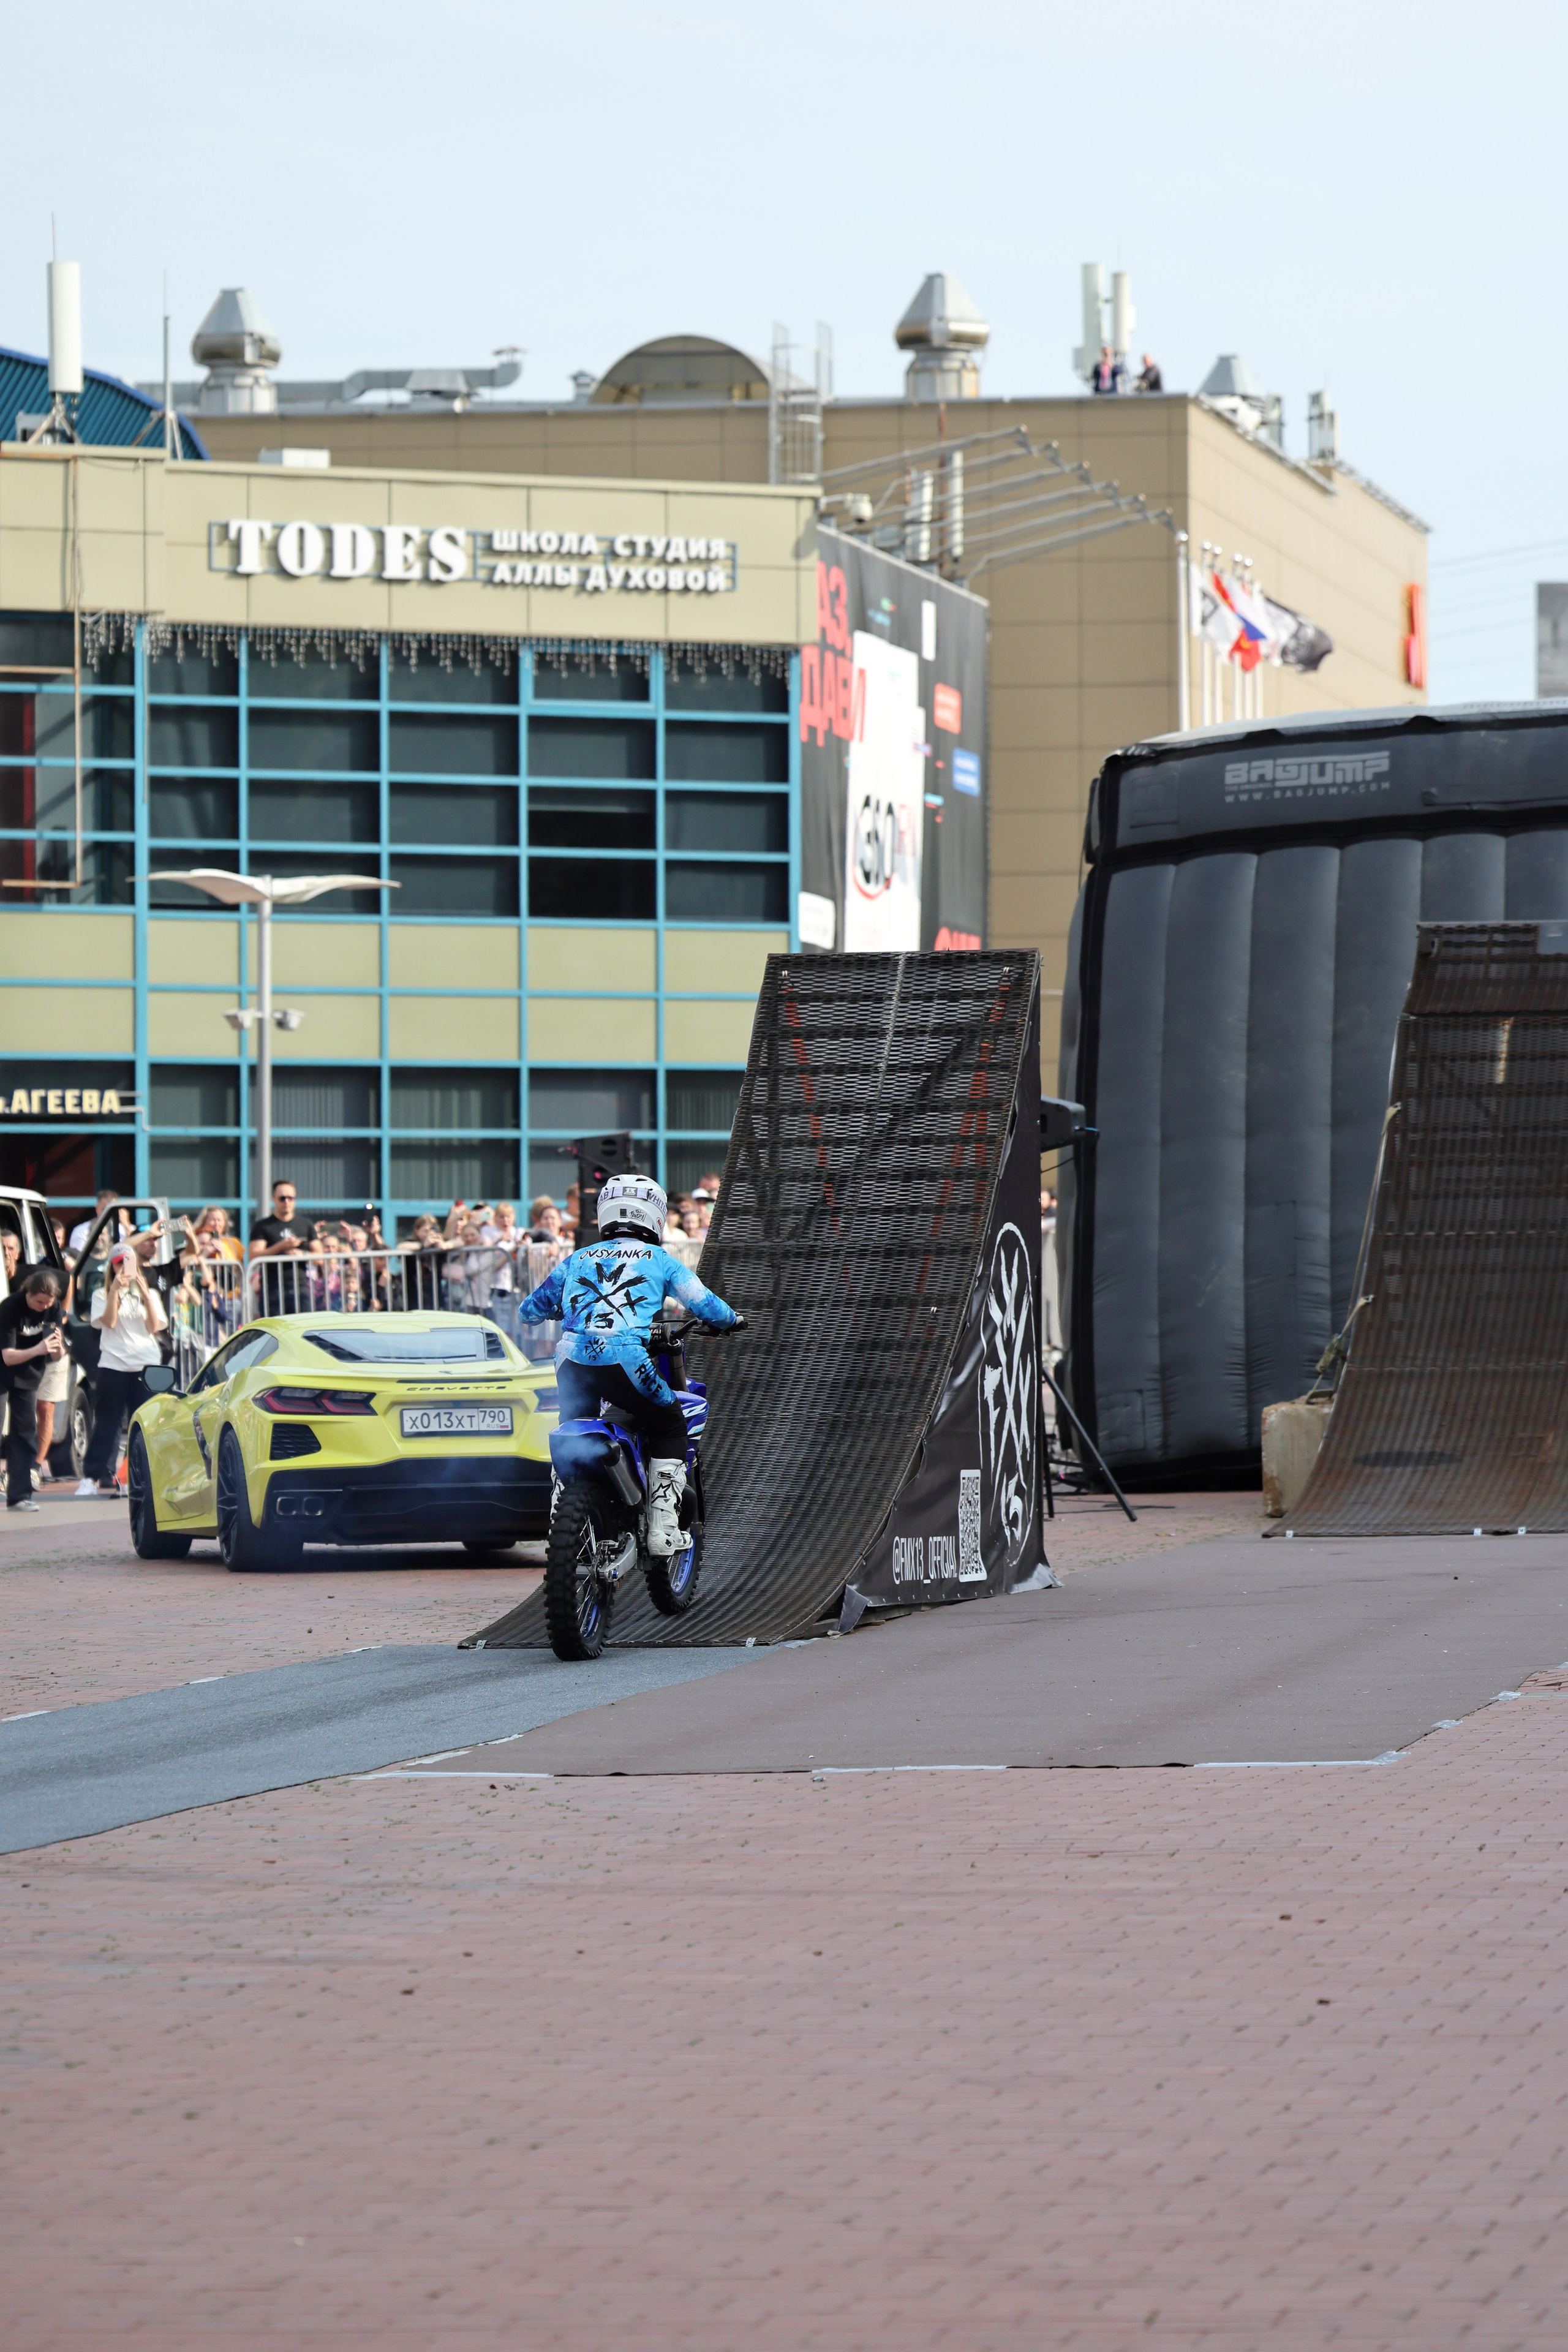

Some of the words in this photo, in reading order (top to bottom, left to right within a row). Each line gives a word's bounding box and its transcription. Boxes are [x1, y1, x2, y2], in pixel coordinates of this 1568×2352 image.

[228, 519, 468, 582] TODES
[492, 529, 599, 556] ШКОЛА
[613, 534, 727, 563] СТУДИЯ
[492, 561, 578, 586] АЛЛЫ
[585, 563, 727, 592] ДУХОВОЙ
[1225, 751, 1390, 787] BAGJUMP
[1225, 782, 1390, 804] WWW.BAGJUMP.COM
[579, 1249, 652, 1260] OVSYANKA
[635, 1363, 663, 1398] RACE
[479, 1410, 506, 1423] 790
[892, 1536, 957, 1585] @FMX13_OFFICIAL
